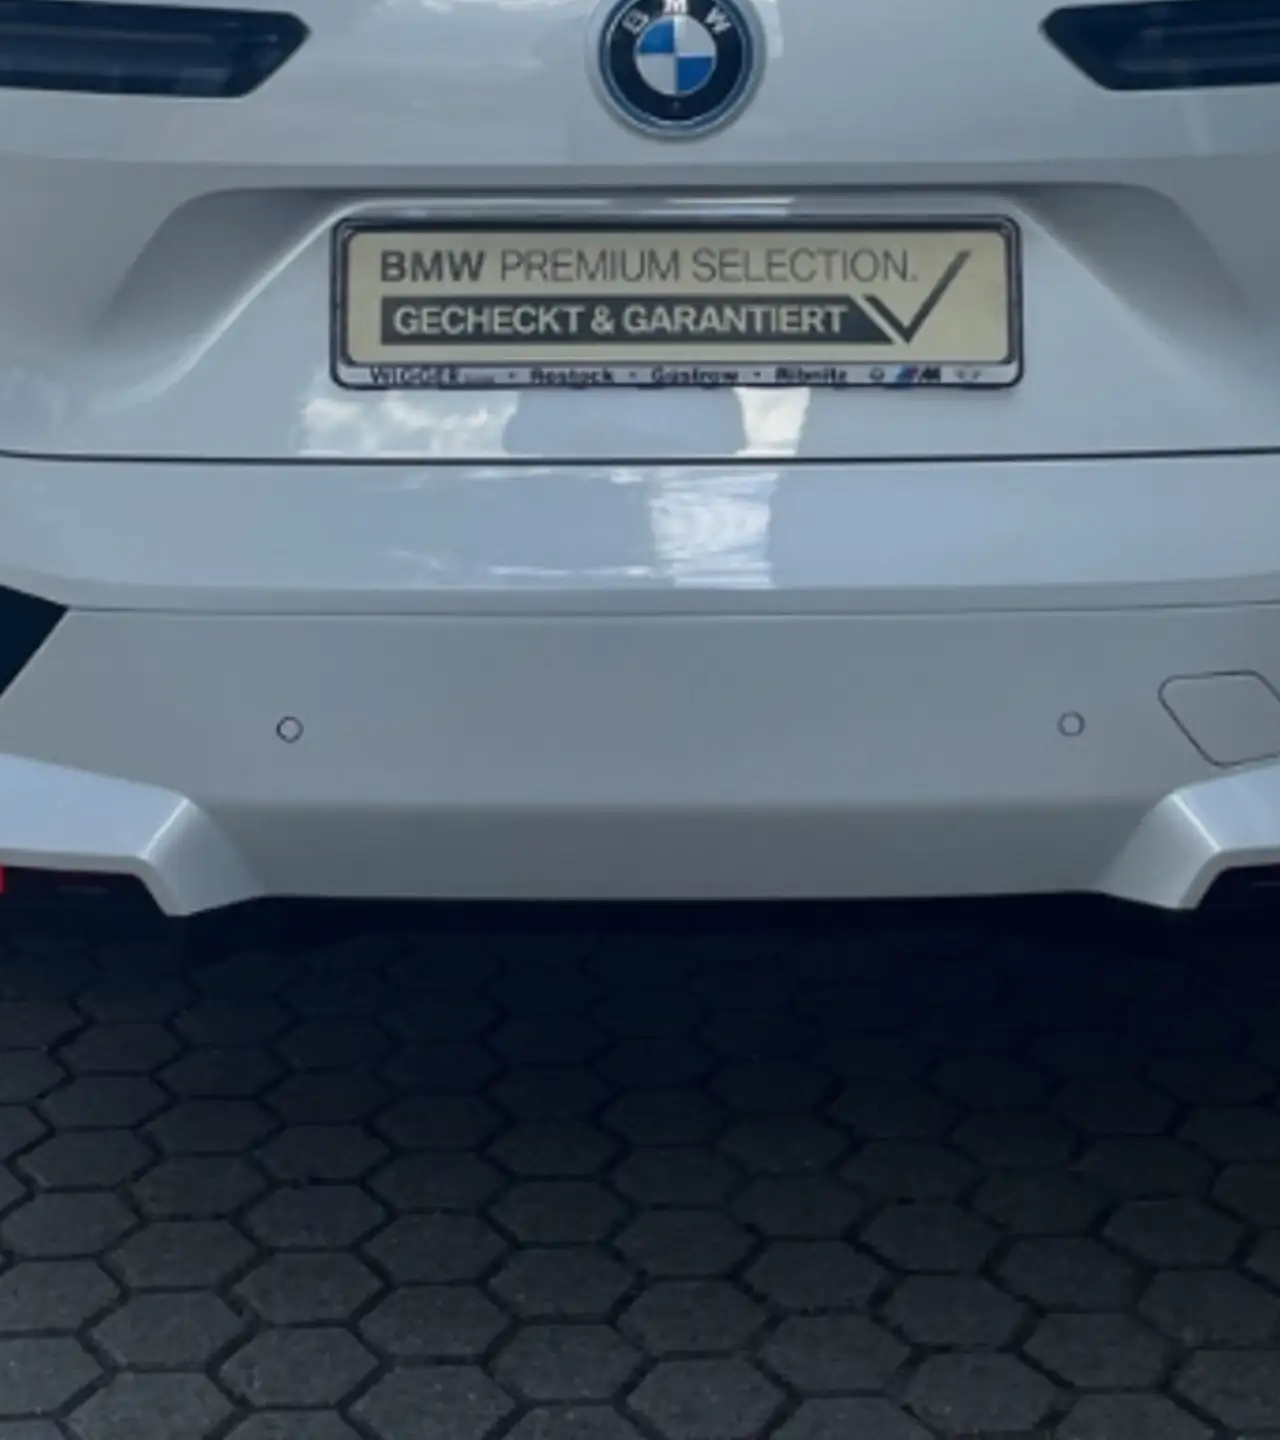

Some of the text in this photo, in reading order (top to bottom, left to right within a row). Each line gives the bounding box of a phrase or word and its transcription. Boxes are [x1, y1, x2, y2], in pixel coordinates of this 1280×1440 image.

[381, 250, 486, 282] BMW
[500, 249, 680, 282] PREMIUM
[393, 305, 849, 335] GECHECKT & GARANTIERT
